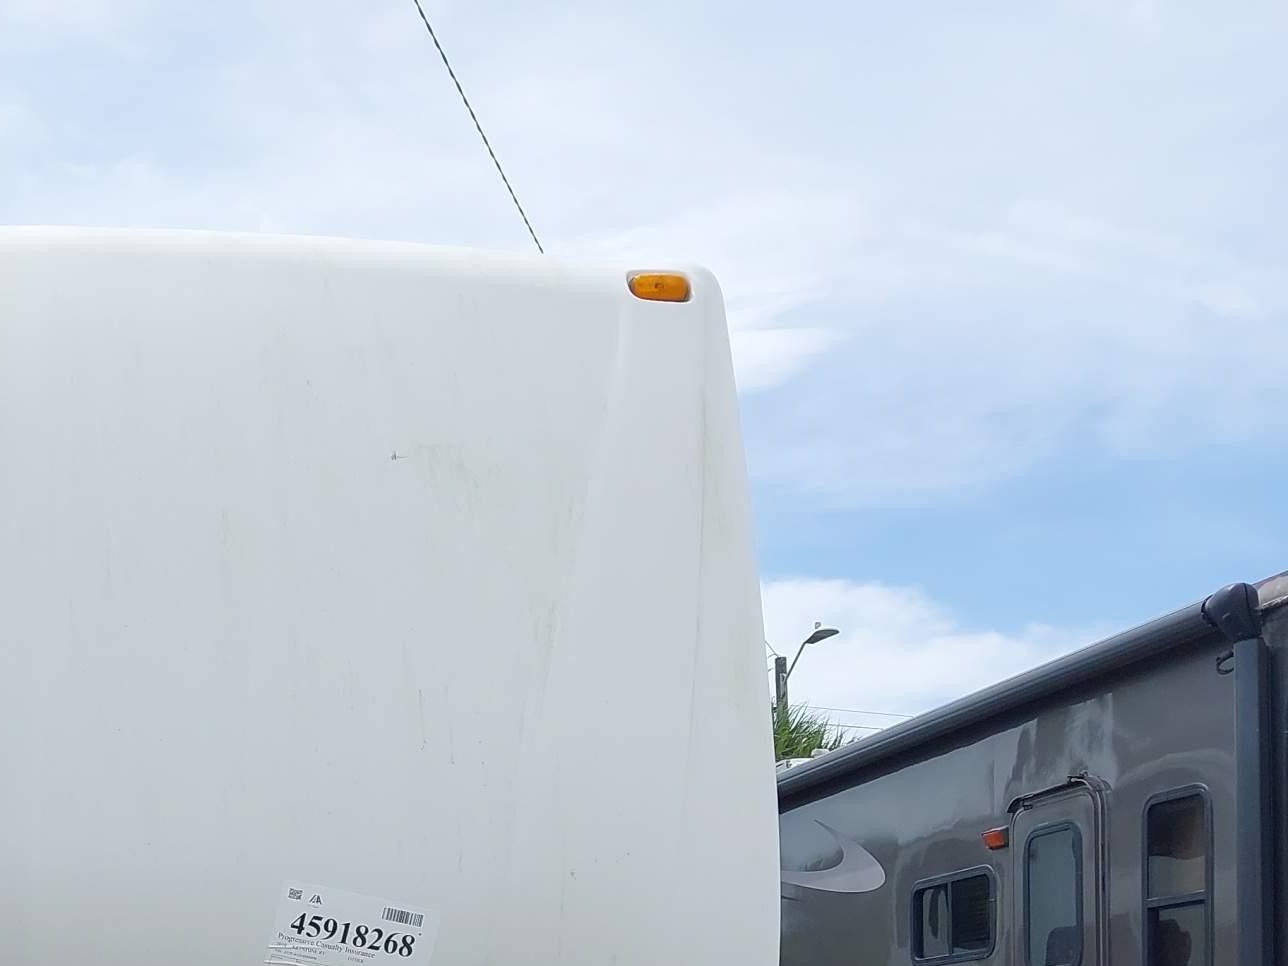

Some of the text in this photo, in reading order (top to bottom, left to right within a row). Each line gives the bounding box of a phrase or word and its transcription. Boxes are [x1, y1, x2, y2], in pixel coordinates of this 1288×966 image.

[278, 932, 316, 946] Progressive
[316, 940, 343, 953] Casualty
[345, 946, 377, 959] Insurance
[290, 912, 416, 958] 45918268
